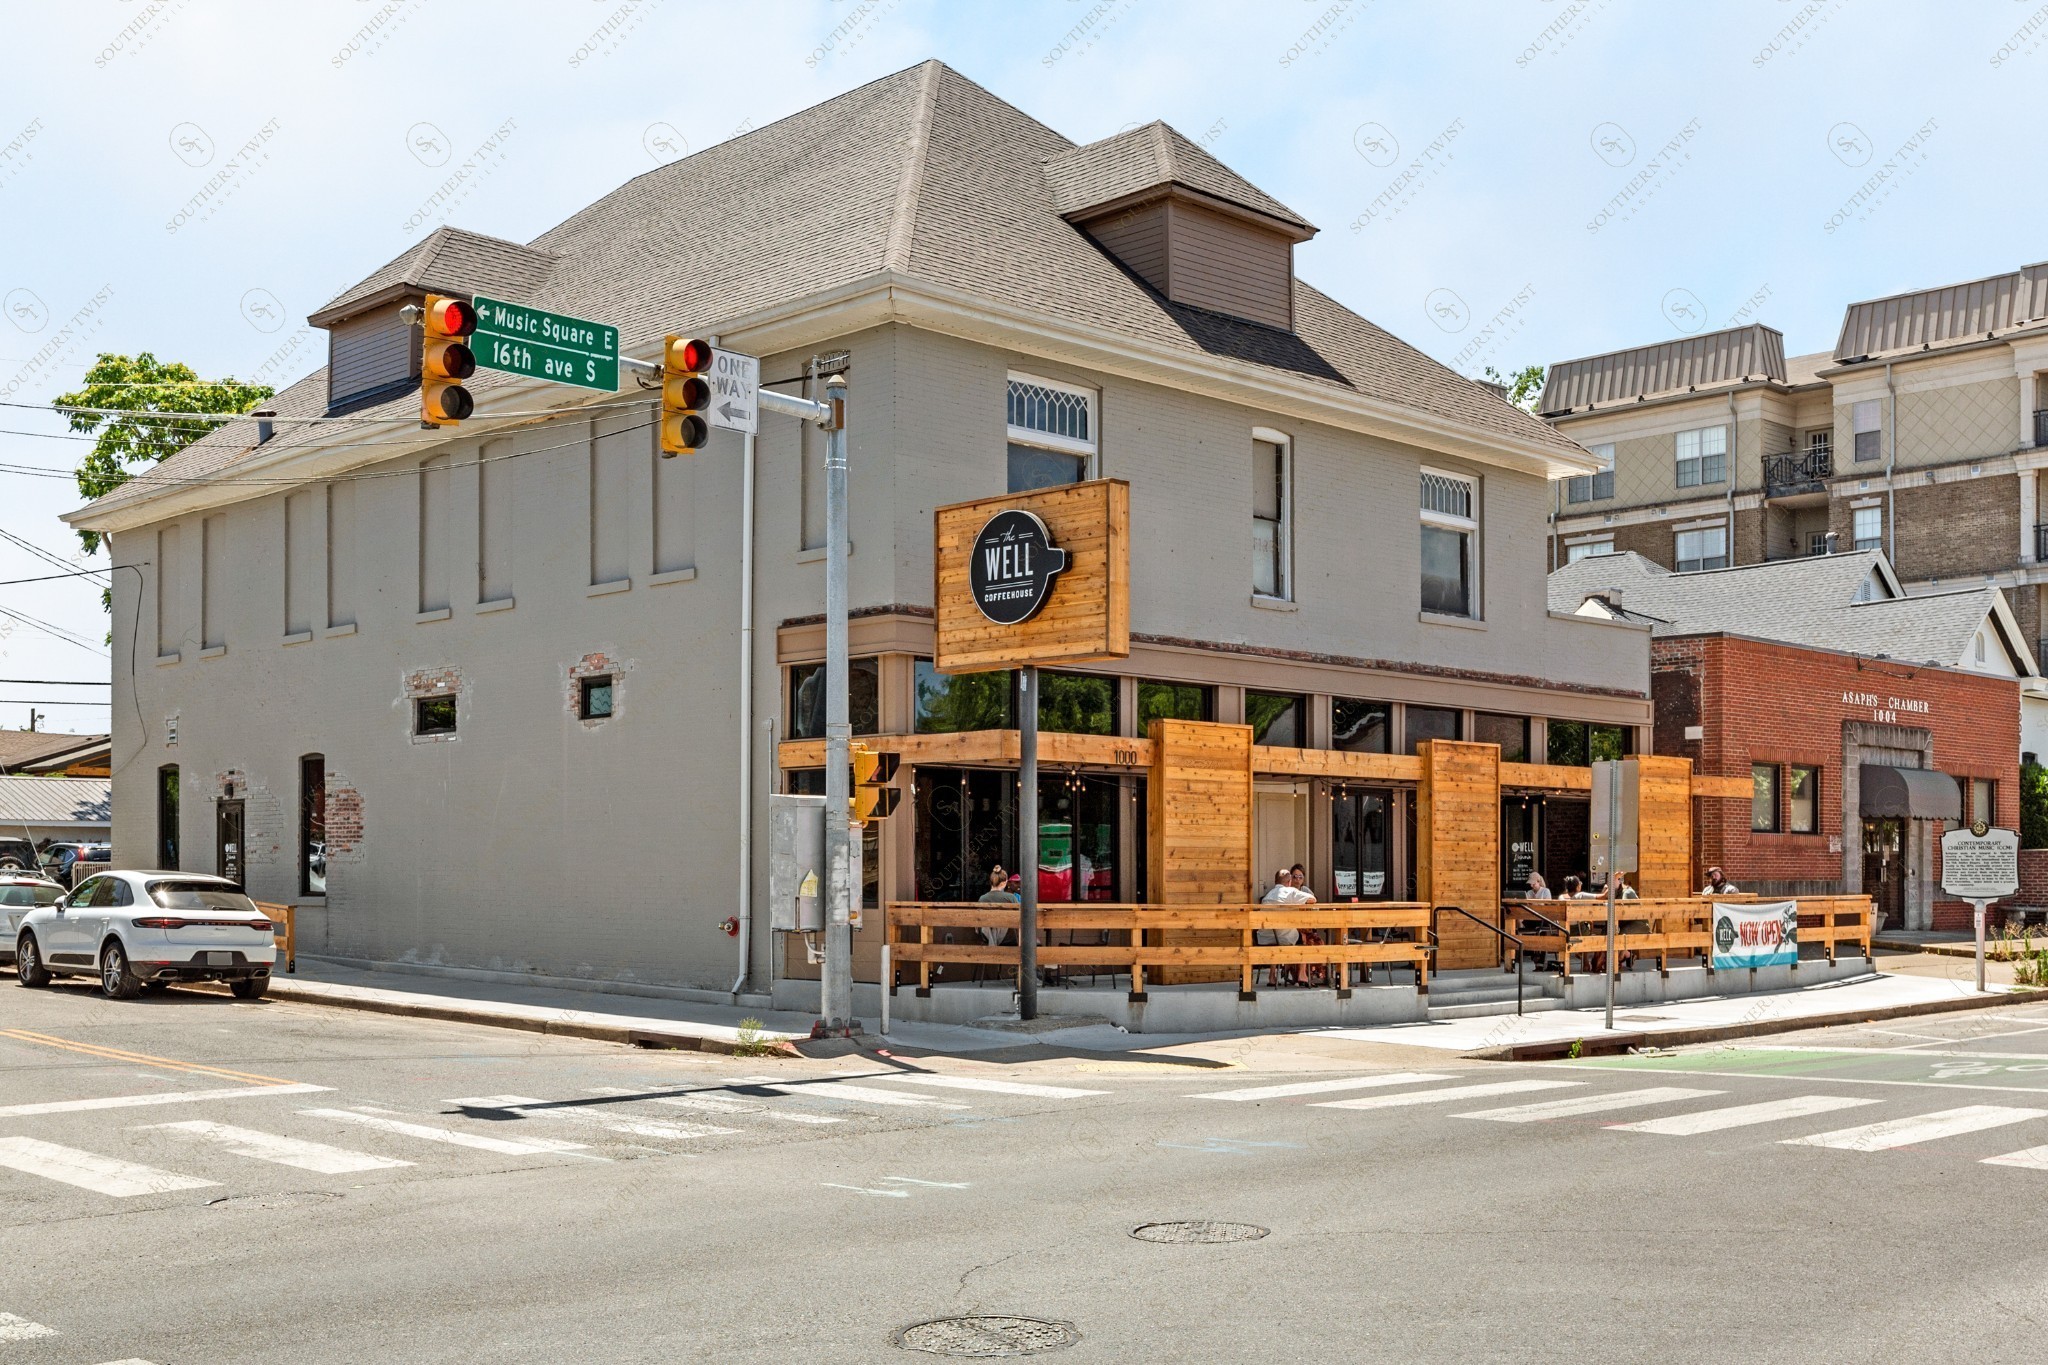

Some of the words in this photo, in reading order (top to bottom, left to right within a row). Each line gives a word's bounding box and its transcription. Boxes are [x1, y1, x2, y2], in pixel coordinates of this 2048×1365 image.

[495, 306, 537, 334] Music
[542, 318, 594, 346] Square
[604, 330, 613, 350] E
[493, 341, 532, 370] 16th
[545, 358, 573, 378] ave
[586, 360, 596, 382] S
[718, 356, 750, 379] ONE
[716, 377, 750, 399] WAY
[1000, 524, 1016, 542] the
[985, 542, 1034, 581] WELL
[984, 588, 1034, 602] COFFEEHOUSE
[1842, 691, 1878, 707] ASAPH'S
[1888, 697, 1929, 713] CHAMBER
[1873, 710, 1896, 723] 1004
[1114, 750, 1137, 765] 1000
[1740, 921, 1760, 947] NOW
[1762, 920, 1783, 946] OPEN
